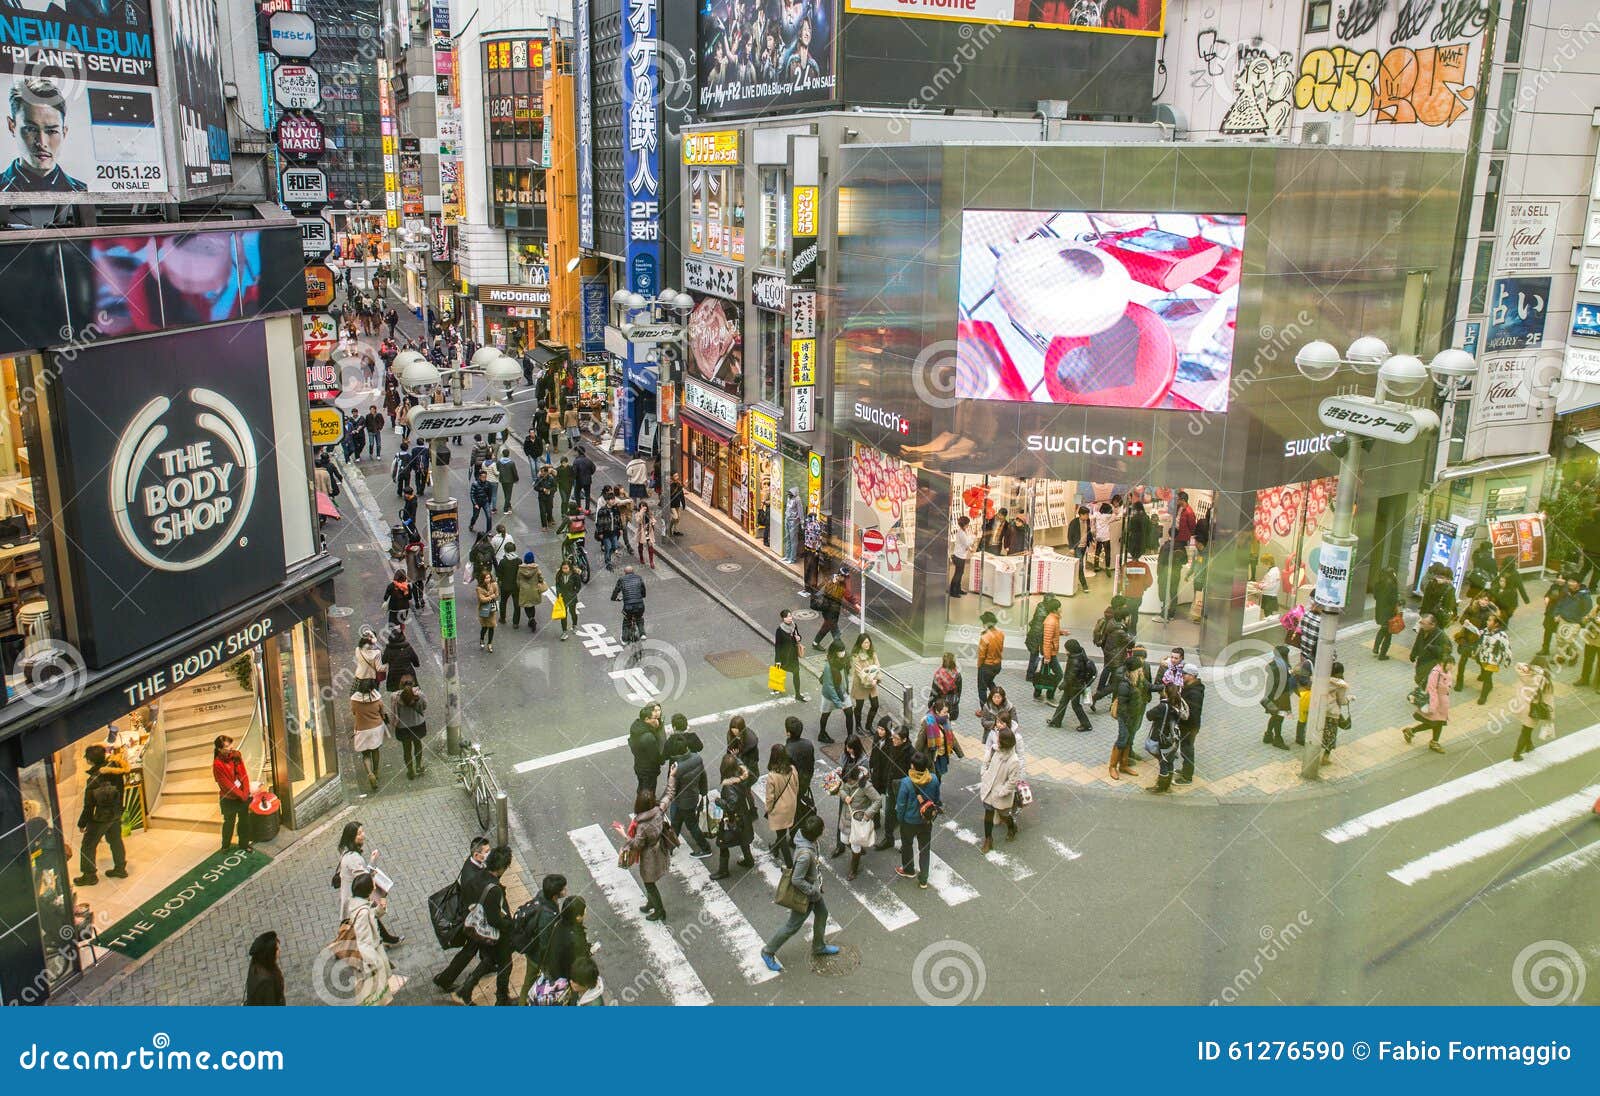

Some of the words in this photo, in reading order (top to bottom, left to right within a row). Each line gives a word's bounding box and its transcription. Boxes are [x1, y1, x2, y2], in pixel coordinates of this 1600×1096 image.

[0, 14, 62, 47] NEW
[66, 26, 151, 58] ALBUM
[742, 85, 755, 99] LIVE
[793, 65, 811, 91] 2.4
[820, 75, 836, 88] SALE
[290, 97, 307, 108] 6F
[282, 139, 320, 150] MARU
[96, 165, 161, 180] 2015.1.28
[289, 174, 321, 190] 和民
[111, 181, 124, 190] ON
[1511, 206, 1522, 217] BUY
[1527, 205, 1550, 217] SELL
[1491, 284, 1544, 326] 占い
[1525, 332, 1541, 345] 2F
[306, 365, 337, 385] HUB
[1504, 360, 1526, 372] SELL
[418, 411, 504, 431] 渋谷センター街
[854, 401, 901, 433] swatch
[1324, 405, 1413, 434] 渋谷センター街
[1026, 434, 1126, 456] swatch
[1285, 431, 1346, 458] swatc
[158, 440, 213, 476] THE
[143, 462, 234, 517] BODY
[153, 496, 233, 545] SHOP
[123, 671, 168, 706] THE
[171, 640, 226, 686] BODY
[107, 920, 153, 948] THE
[153, 881, 206, 919] BODY
